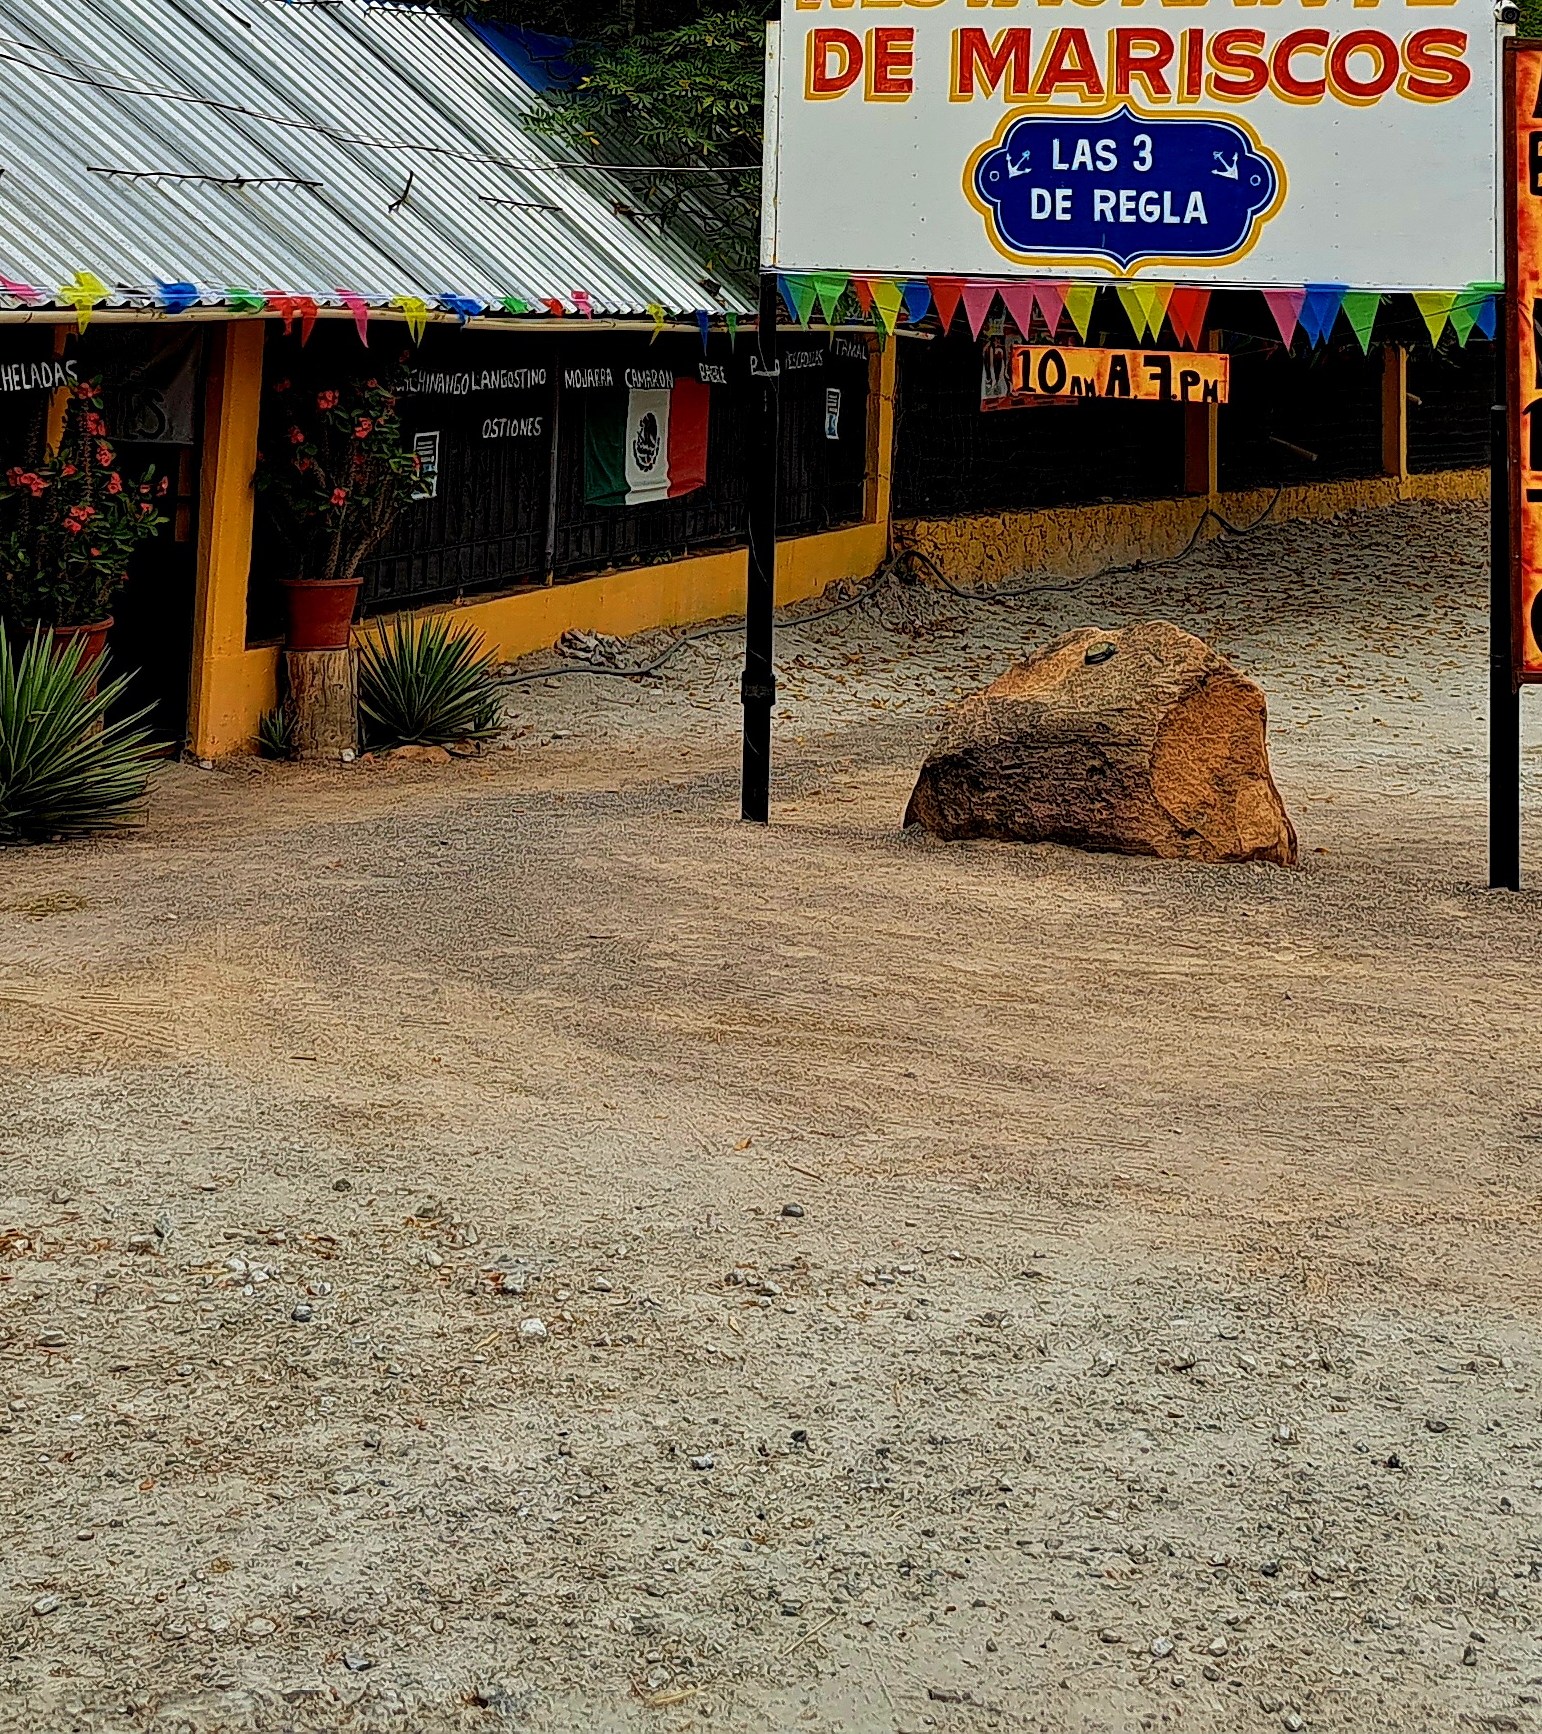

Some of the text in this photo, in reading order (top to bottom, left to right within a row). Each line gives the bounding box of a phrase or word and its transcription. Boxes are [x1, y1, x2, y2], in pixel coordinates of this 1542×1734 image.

[805, 27, 1471, 107] DE MARISCOS
[1053, 134, 1153, 172] LAS 3
[1031, 188, 1208, 224] DE REGLA
[472, 369, 546, 390] LANGOSTINO
[565, 368, 614, 389] MOJARRA
[625, 368, 674, 389] CAMARON
[482, 417, 543, 439] OSTIONES
